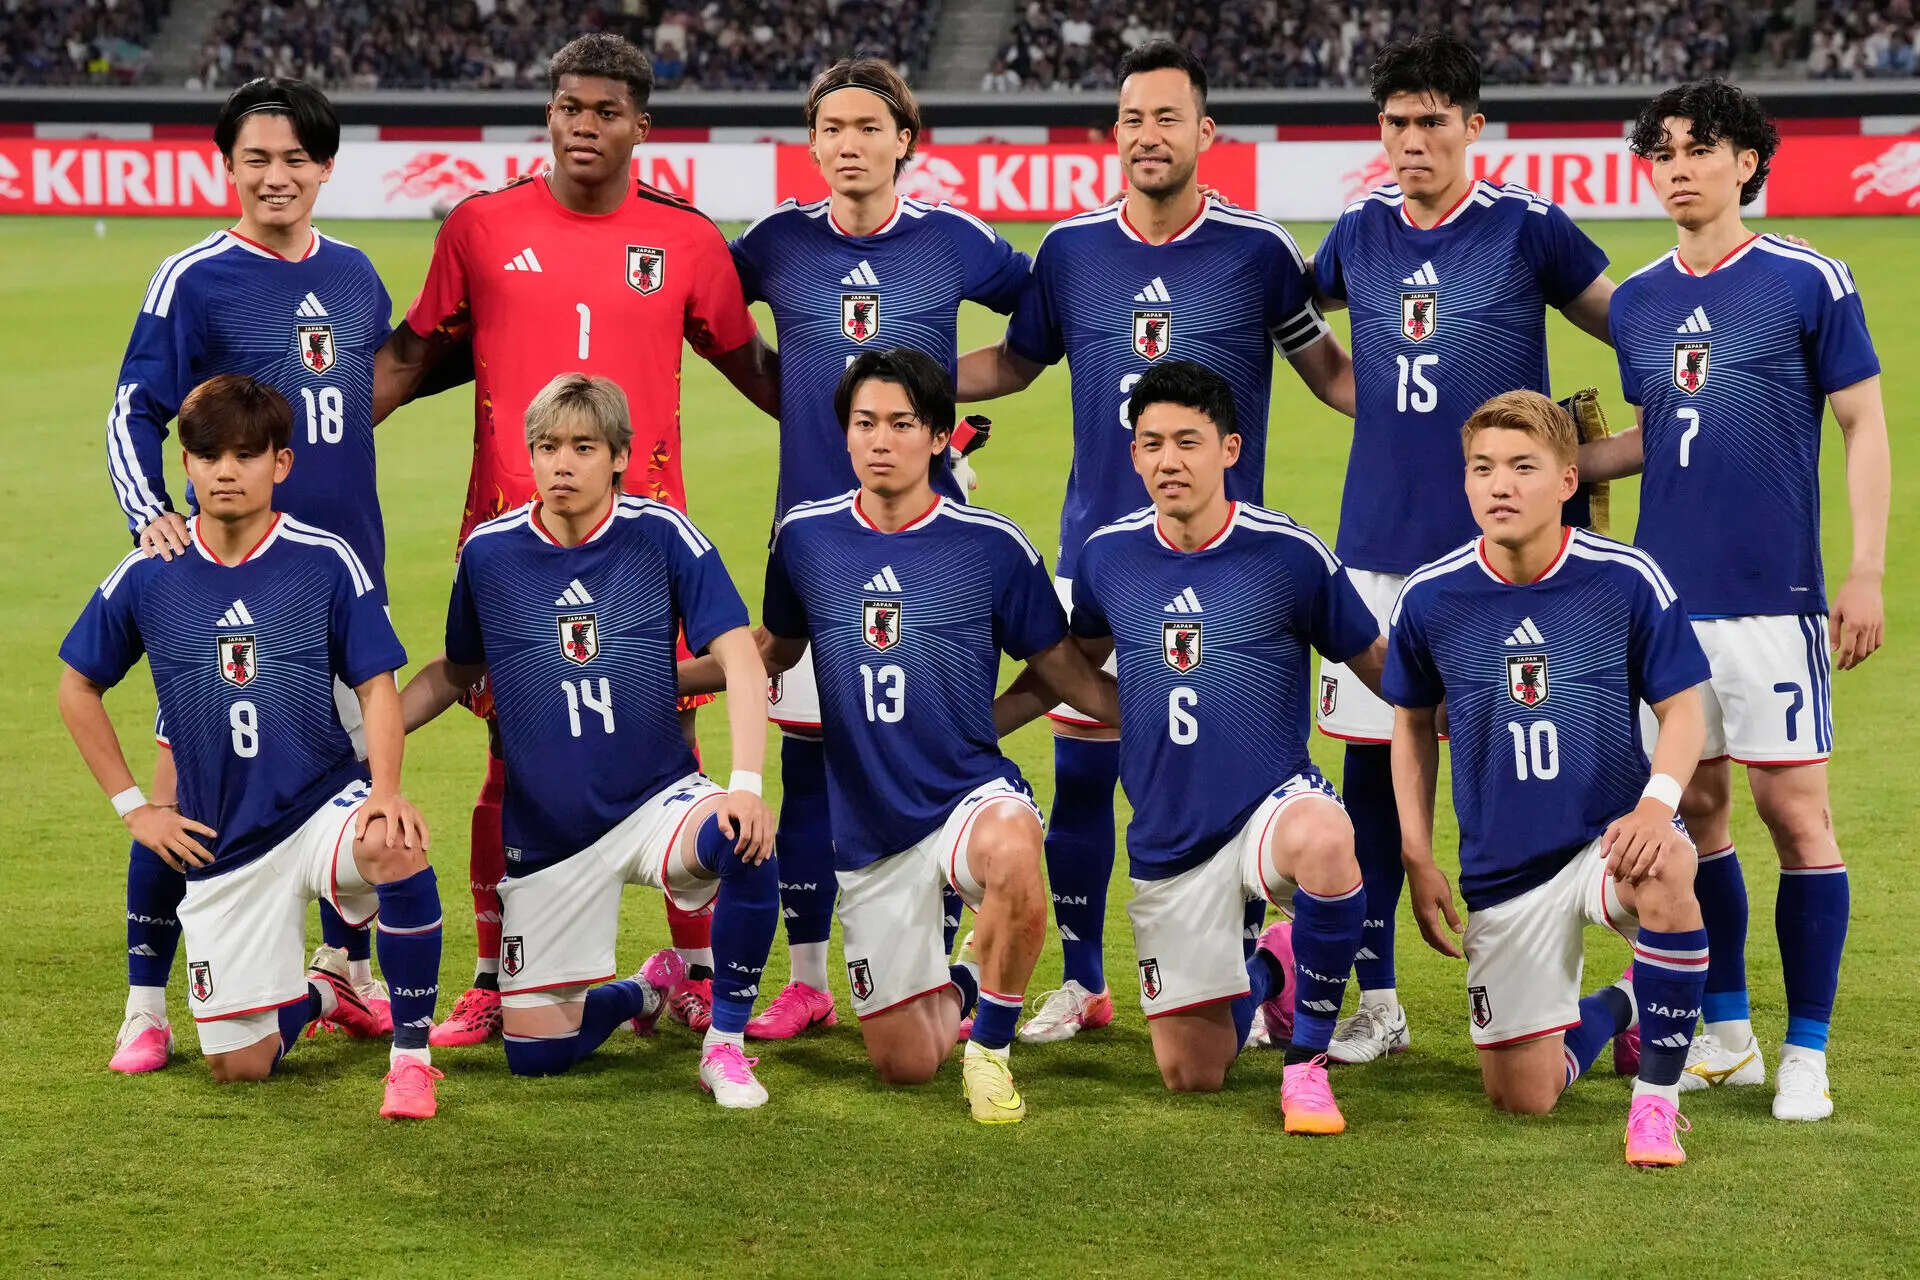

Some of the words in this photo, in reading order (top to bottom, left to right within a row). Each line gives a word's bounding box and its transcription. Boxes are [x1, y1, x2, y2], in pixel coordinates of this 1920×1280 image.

[32, 148, 227, 206] KIRIN
[978, 153, 1121, 211] KIRI
[636, 247, 656, 255] JAPAN
[576, 302, 591, 360] 1
[1397, 354, 1439, 413] 15
[301, 386, 344, 444] 18
[1676, 408, 1699, 468] 7
[561, 677, 615, 737] 14
[859, 664, 905, 723] 13
[1169, 686, 1198, 746] 6
[1773, 682, 1803, 742] 7
[229, 700, 259, 758] 8
[1508, 720, 1559, 781] 10
[778, 880, 817, 891] PAN
[1052, 893, 1088, 905] PAN
[728, 961, 766, 974] JAP
